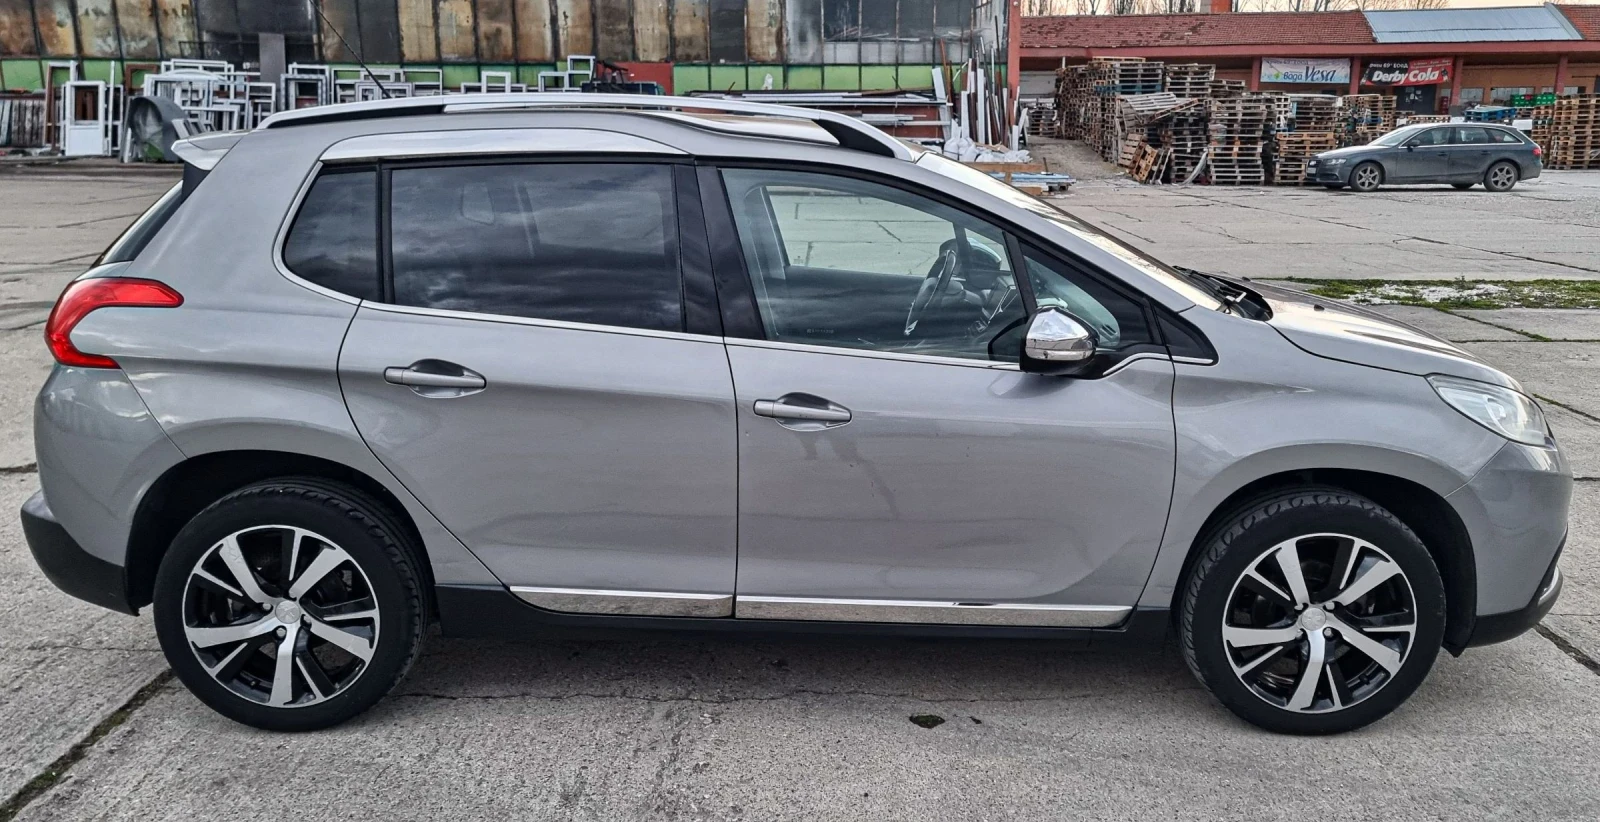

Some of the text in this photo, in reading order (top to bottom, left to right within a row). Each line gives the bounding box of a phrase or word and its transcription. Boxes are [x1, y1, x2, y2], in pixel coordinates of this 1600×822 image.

[1304, 65, 1337, 82] Vesa
[1372, 67, 1440, 84] Derby Cola
